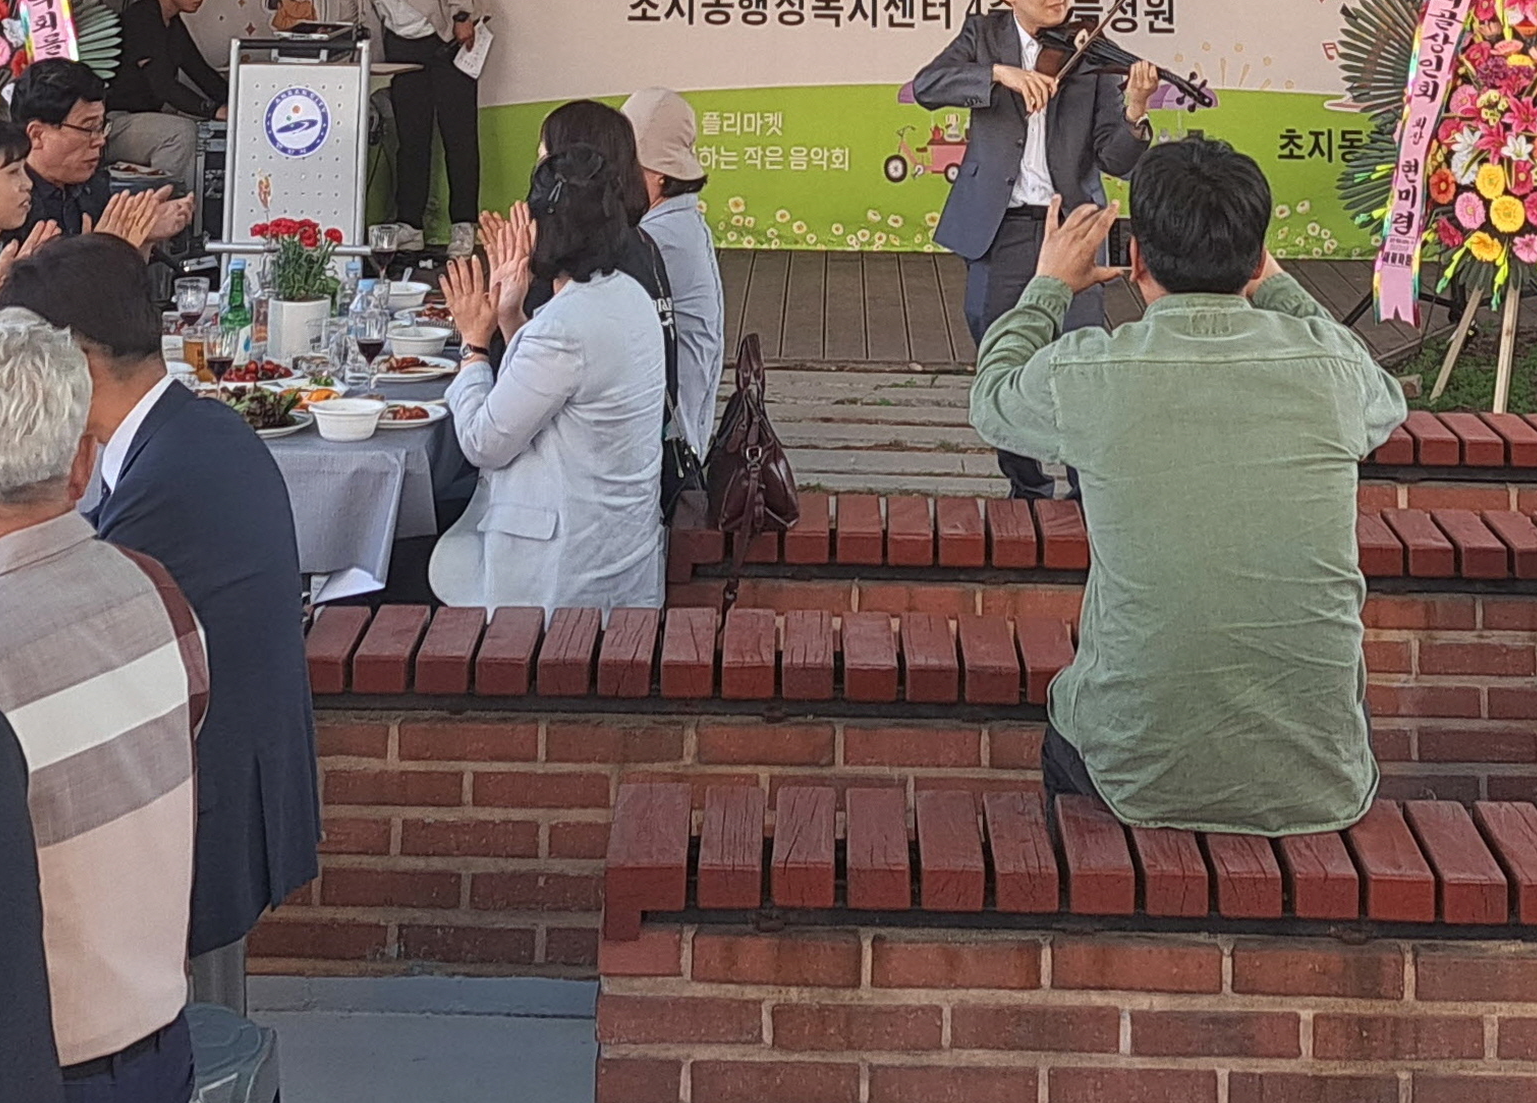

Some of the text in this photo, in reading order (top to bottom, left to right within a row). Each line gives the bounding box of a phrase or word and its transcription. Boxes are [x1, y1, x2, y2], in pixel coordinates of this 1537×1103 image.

[702, 111, 783, 136] 플리마켓
[1277, 128, 1382, 163] 초지동
[692, 146, 850, 172] 하는 작은 음악회
